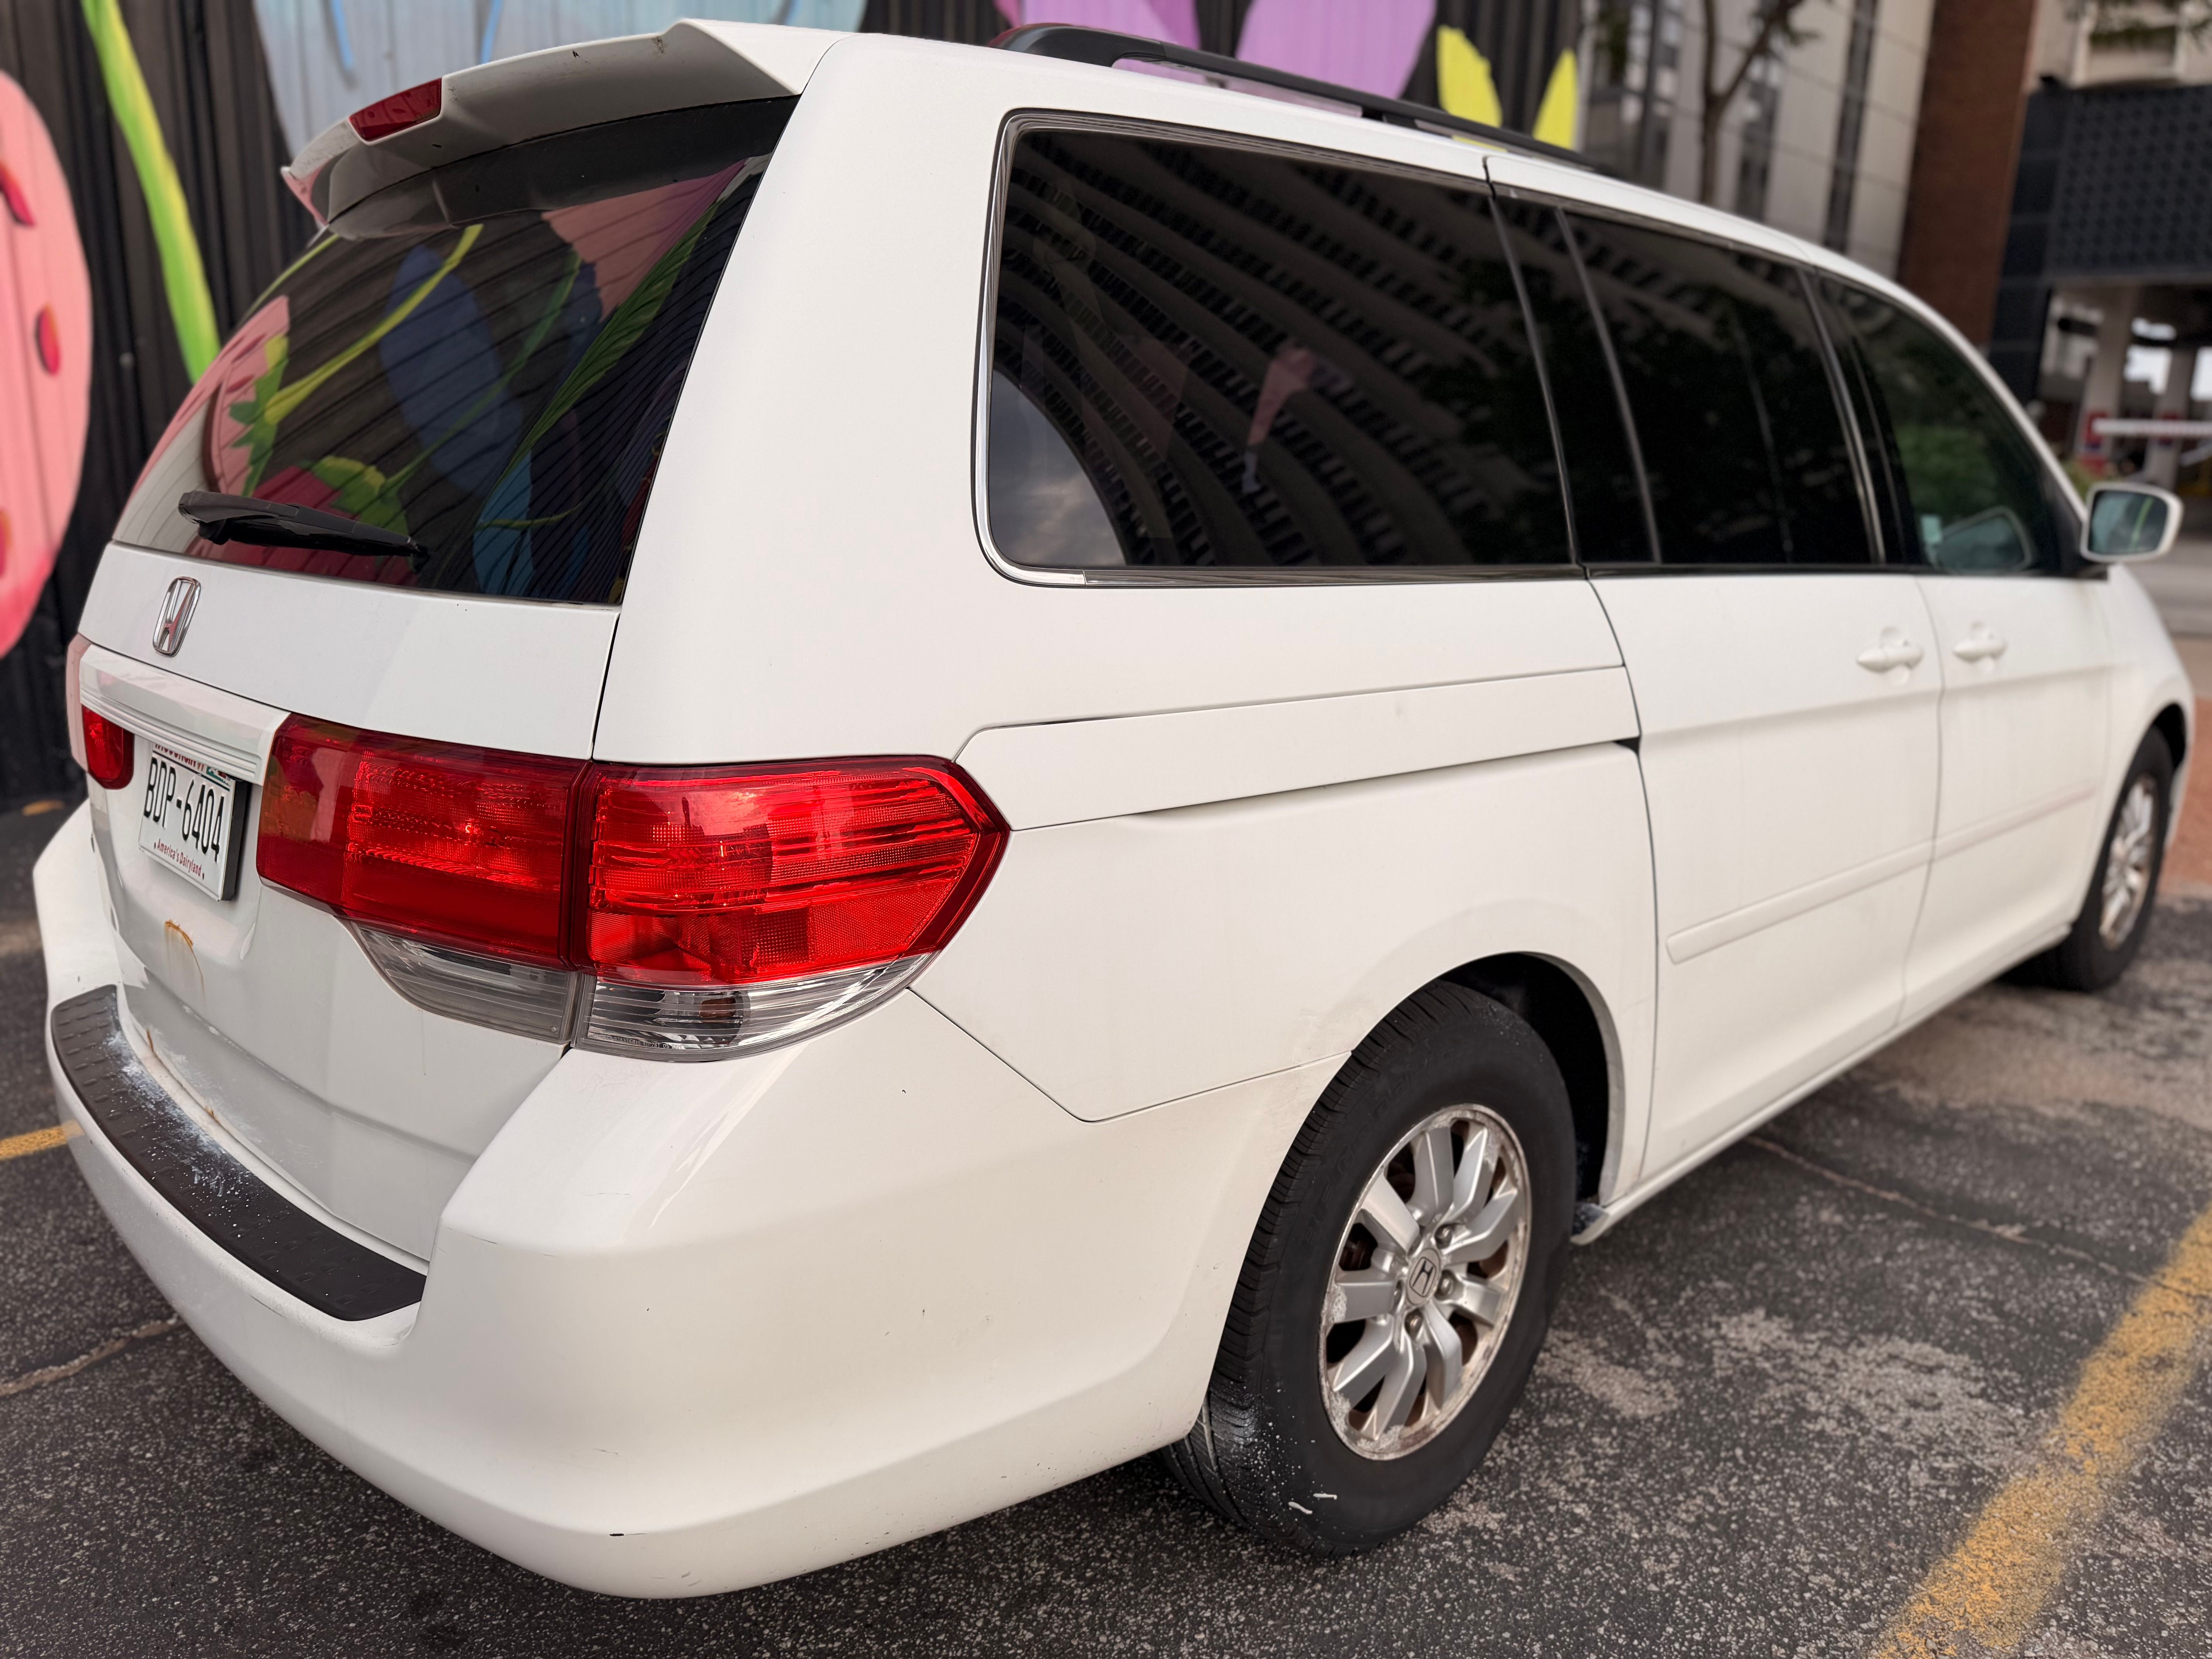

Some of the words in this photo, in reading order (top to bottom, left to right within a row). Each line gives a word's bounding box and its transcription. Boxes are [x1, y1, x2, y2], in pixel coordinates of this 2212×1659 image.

[144, 757, 225, 862] BDP-6404
[157, 838, 180, 862] America's
[179, 852, 202, 876] Dairyland
